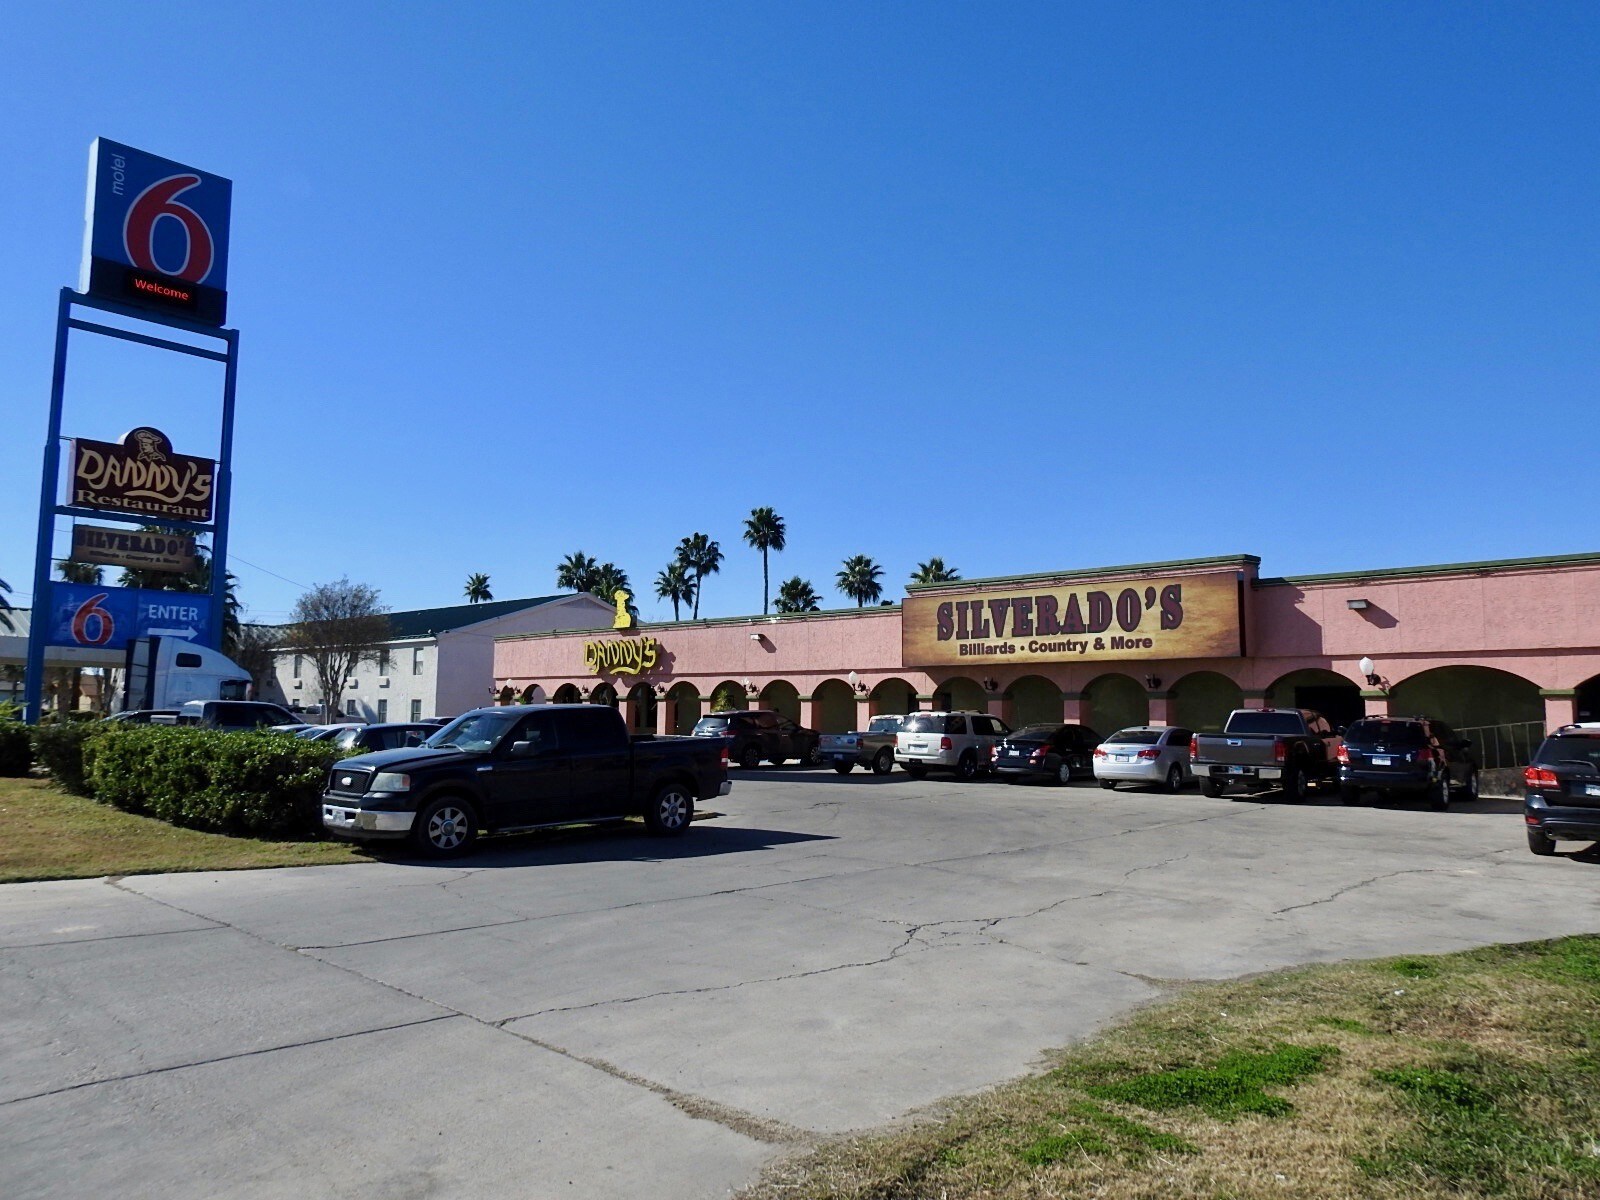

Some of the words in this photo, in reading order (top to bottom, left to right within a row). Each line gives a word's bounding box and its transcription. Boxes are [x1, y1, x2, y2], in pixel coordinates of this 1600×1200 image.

[112, 153, 126, 196] motel
[122, 173, 215, 284] 6
[134, 278, 190, 301] Welcome
[75, 489, 209, 518] Restaurant
[70, 593, 115, 645] 6
[148, 604, 199, 621] ENTER
[936, 584, 1184, 641] SILVERADO'S
[959, 642, 1016, 656] Billiards
[1028, 638, 1088, 655] Country
[1093, 636, 1106, 650] &
[1110, 635, 1153, 650] More
